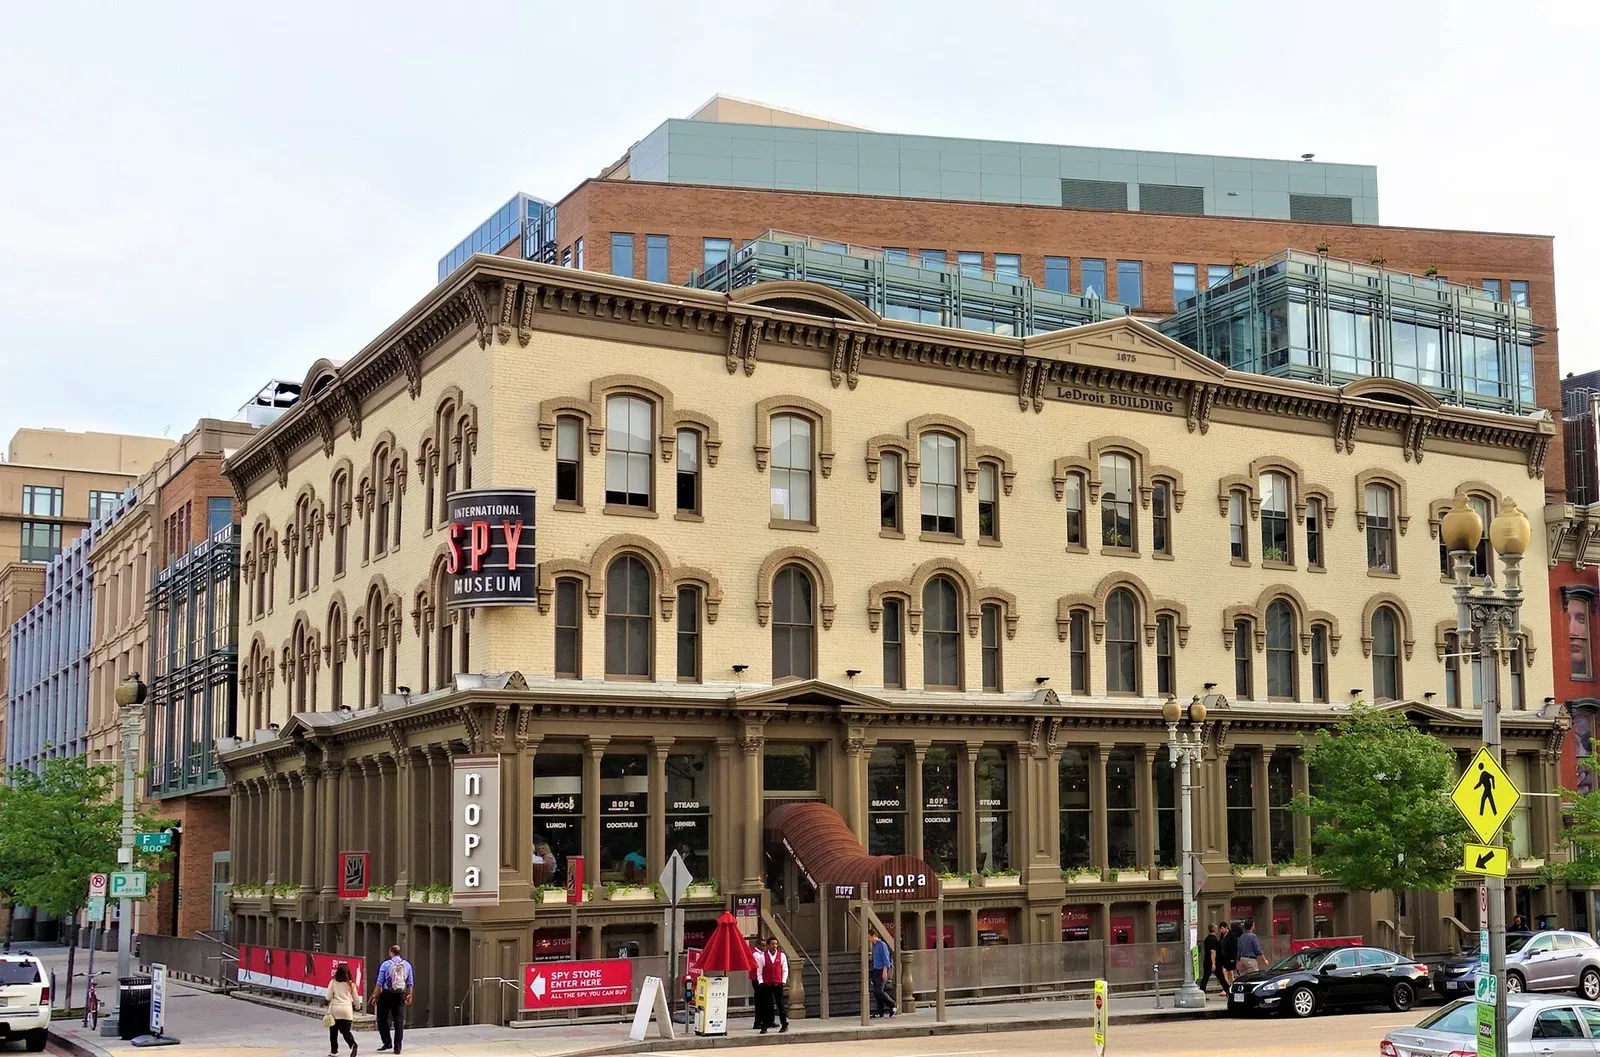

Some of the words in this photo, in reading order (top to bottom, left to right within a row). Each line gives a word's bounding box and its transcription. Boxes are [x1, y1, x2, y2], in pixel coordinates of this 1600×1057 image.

[1117, 353, 1137, 362] 1875
[1057, 387, 1105, 404] LeDroit
[1109, 394, 1173, 412] BUILDING
[454, 505, 521, 519] INTERNATIONAL
[447, 520, 523, 574] SPY
[454, 576, 521, 594] MUSEUM
[540, 801, 575, 810] SEAFOOD
[673, 801, 700, 809] STEAKS
[143, 835, 151, 844] F
[346, 857, 364, 876] SPY
[551, 972, 569, 980] SPY
[572, 970, 602, 979] STORE
[551, 980, 578, 989] ENTER
